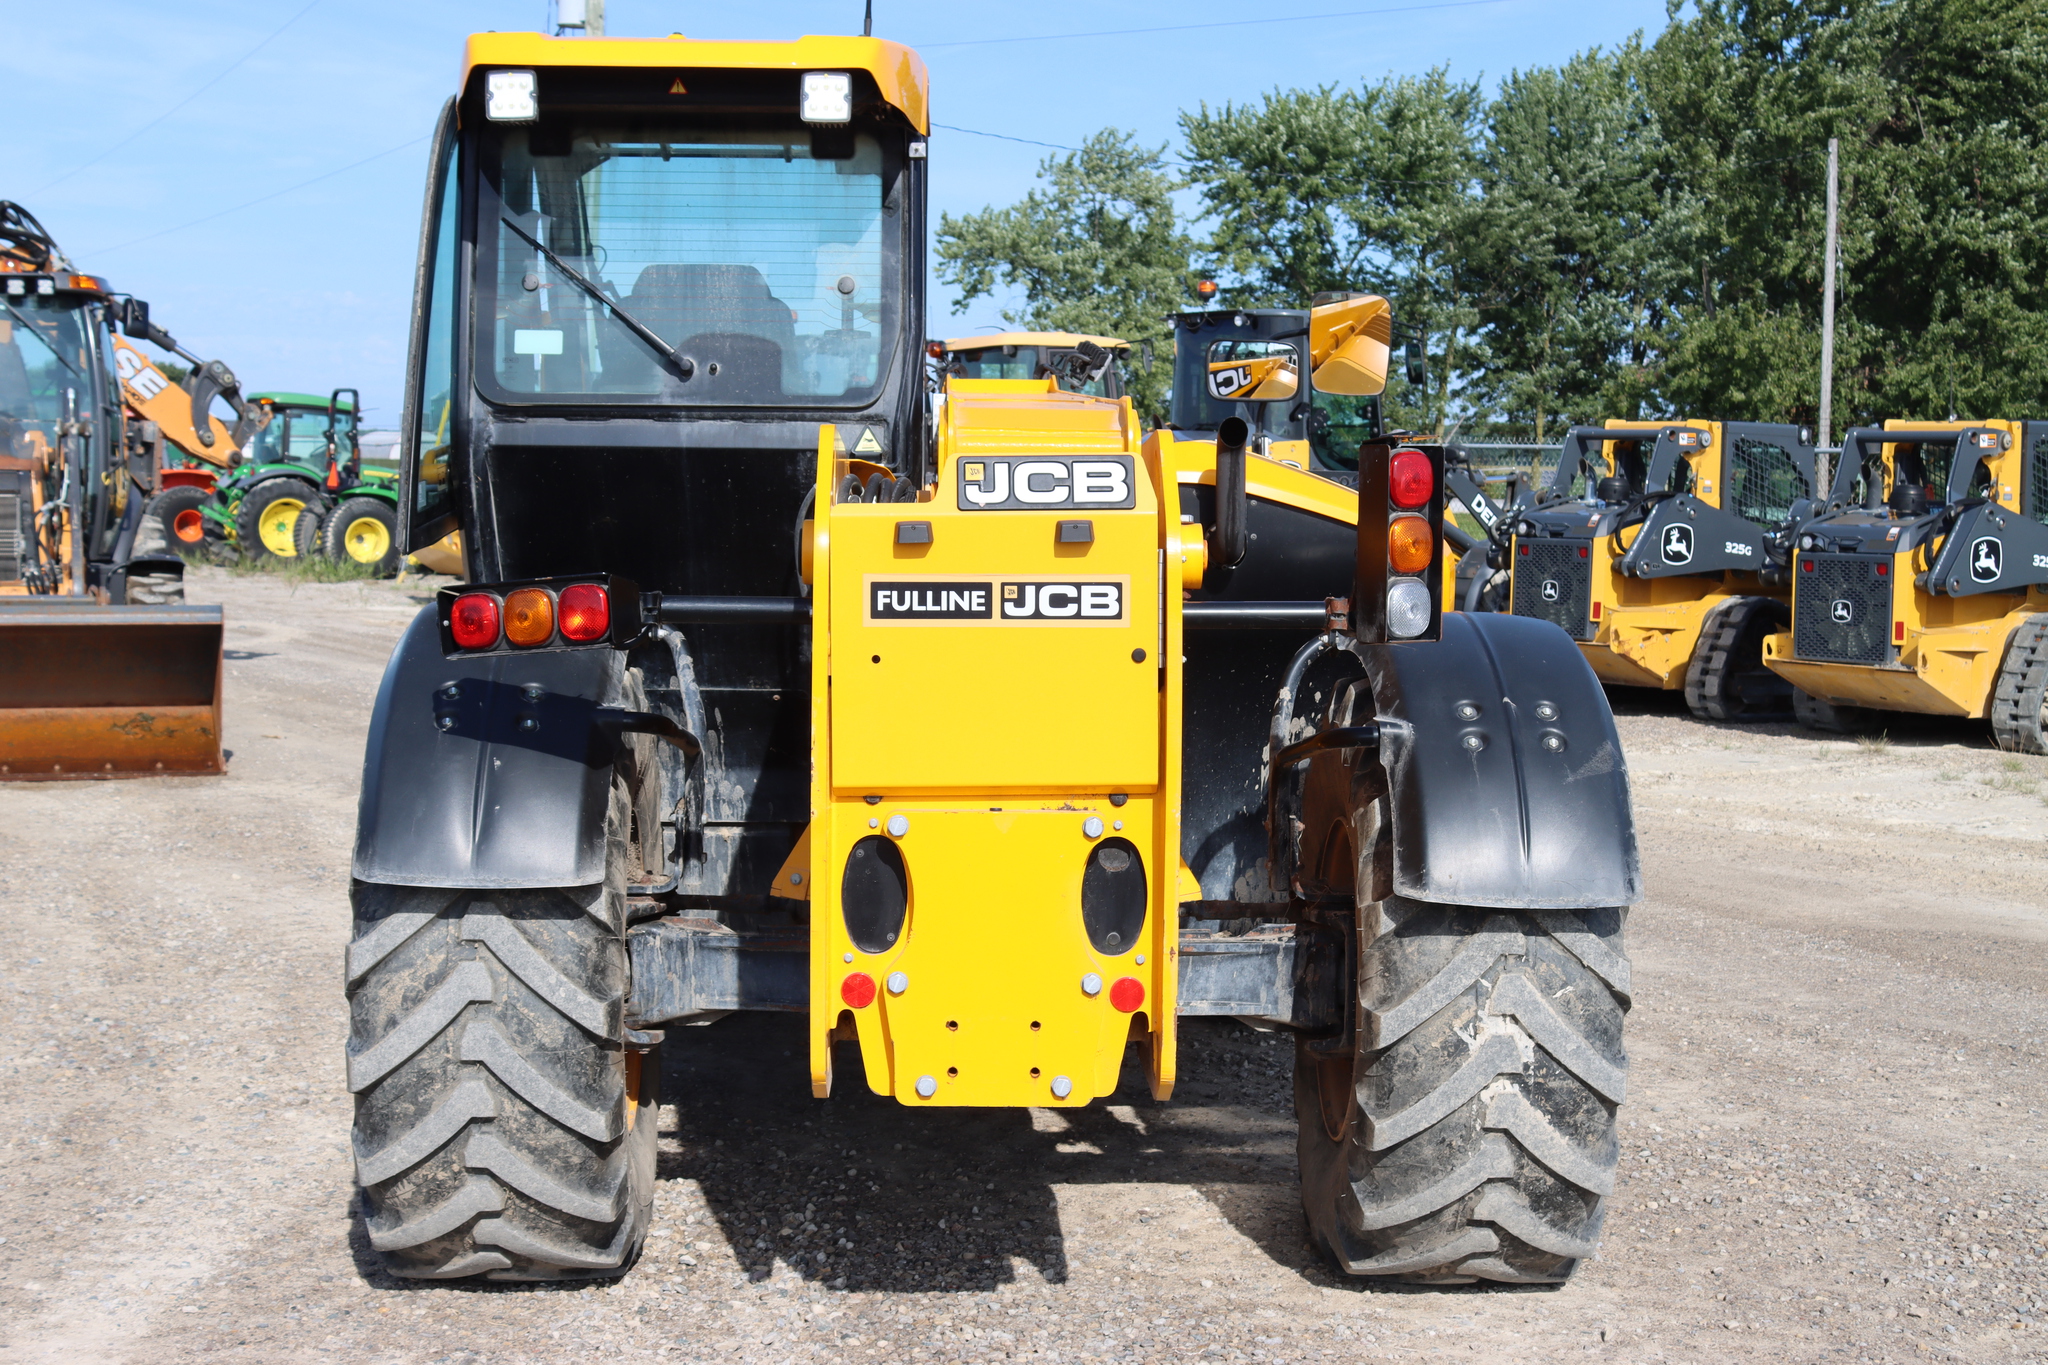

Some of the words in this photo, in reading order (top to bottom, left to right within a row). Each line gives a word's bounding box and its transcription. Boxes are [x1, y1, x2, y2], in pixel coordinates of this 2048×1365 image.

[965, 461, 1129, 504] JCB
[1725, 541, 1752, 556] 325G
[877, 590, 986, 612] FULLINE
[1004, 585, 1120, 617] JCB
